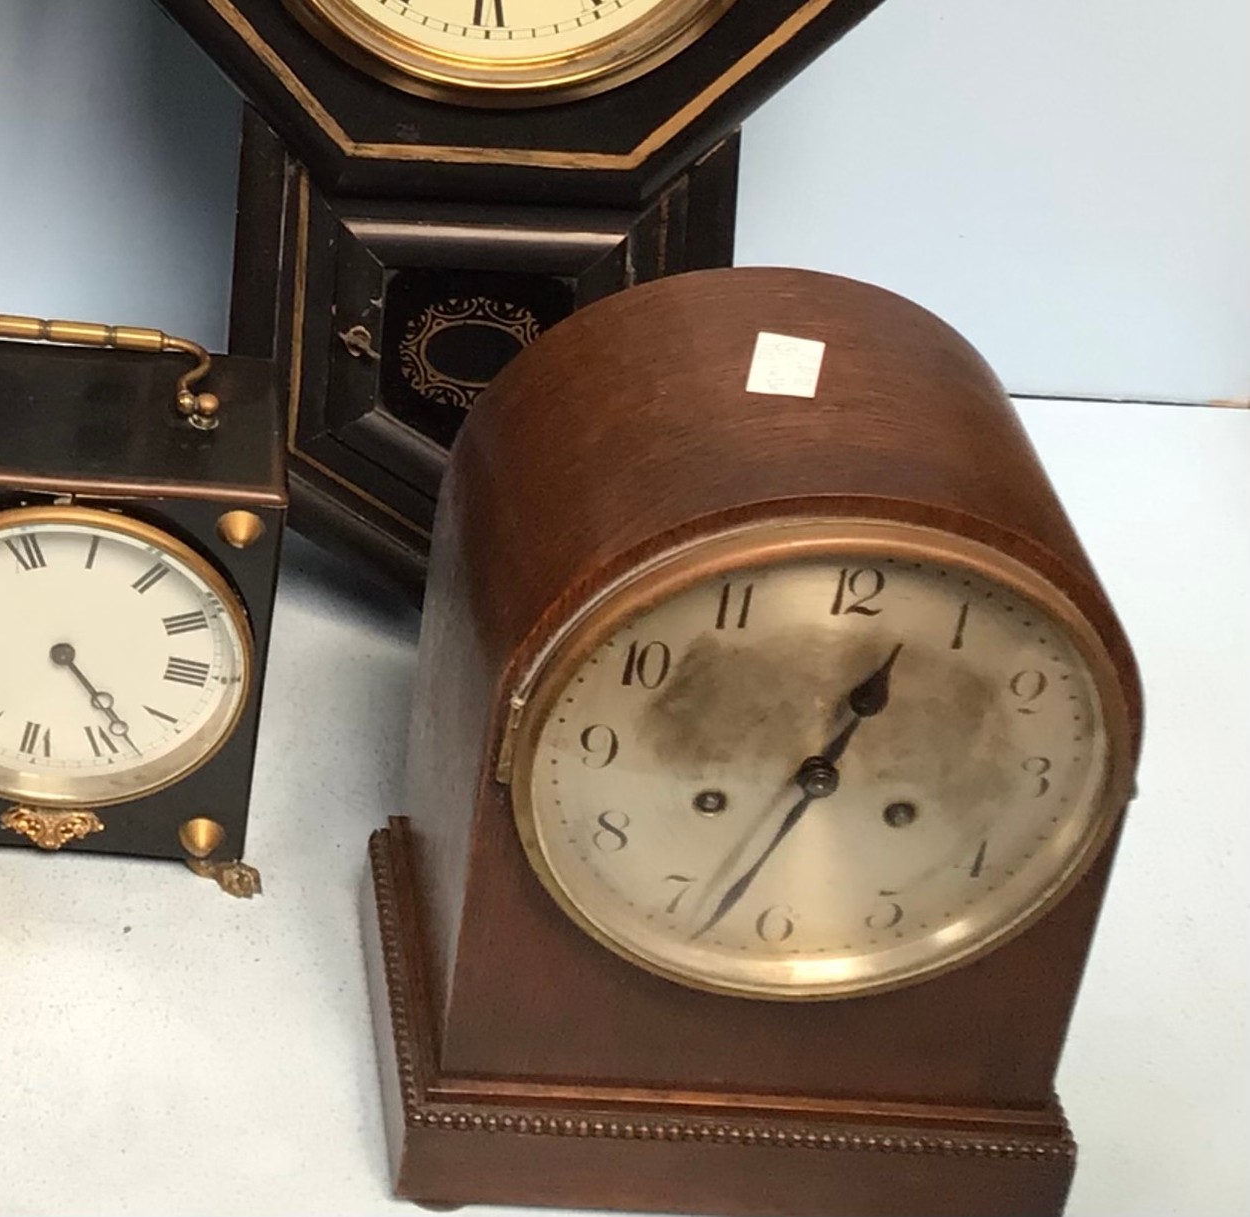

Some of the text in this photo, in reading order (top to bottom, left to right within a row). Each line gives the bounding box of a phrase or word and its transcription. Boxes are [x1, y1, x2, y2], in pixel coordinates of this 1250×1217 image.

[4, 532, 47, 574] XII
[85, 534, 100, 570] I
[131, 562, 172, 595] II
[829, 566, 886, 616] 12
[162, 610, 209, 636] III
[715, 583, 754, 630] 11
[950, 600, 970, 651] 1
[620, 639, 673, 691] 10
[1008, 668, 1049, 715] 2
[19, 721, 50, 758] VII
[83, 725, 119, 758] VI
[580, 724, 620, 770] 9
[1021, 756, 1050, 799] 3
[592, 809, 632, 853] 8
[952, 839, 990, 880] 4
[664, 873, 698, 916] 7
[865, 889, 905, 930] 5
[754, 903, 801, 942] 6
